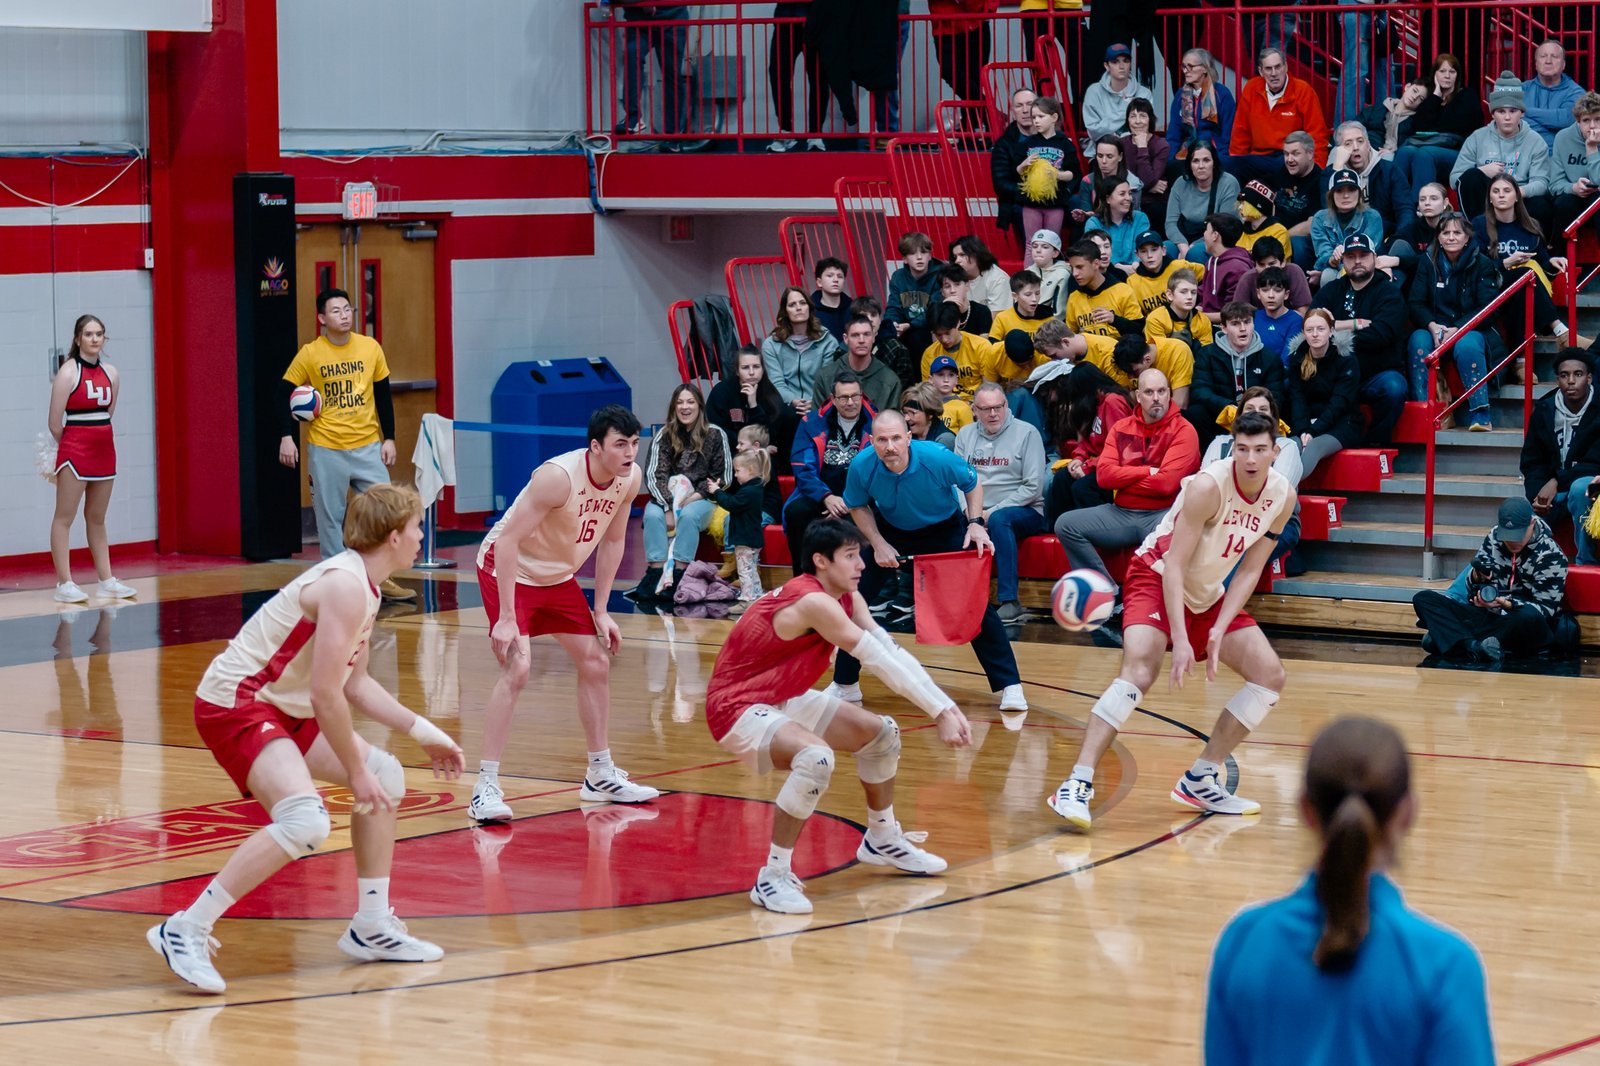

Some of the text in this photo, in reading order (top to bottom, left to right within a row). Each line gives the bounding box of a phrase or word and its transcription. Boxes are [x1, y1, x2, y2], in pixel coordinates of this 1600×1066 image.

[352, 192, 373, 218] EXIT
[261, 279, 288, 290] MAGO
[320, 361, 364, 378] CHASING
[85, 379, 112, 406] LU
[324, 380, 352, 397] GOLD
[325, 393, 365, 408] FOR CURE
[578, 498, 615, 517] LEWIS
[576, 519, 598, 543] 16
[1221, 533, 1245, 559] 14
